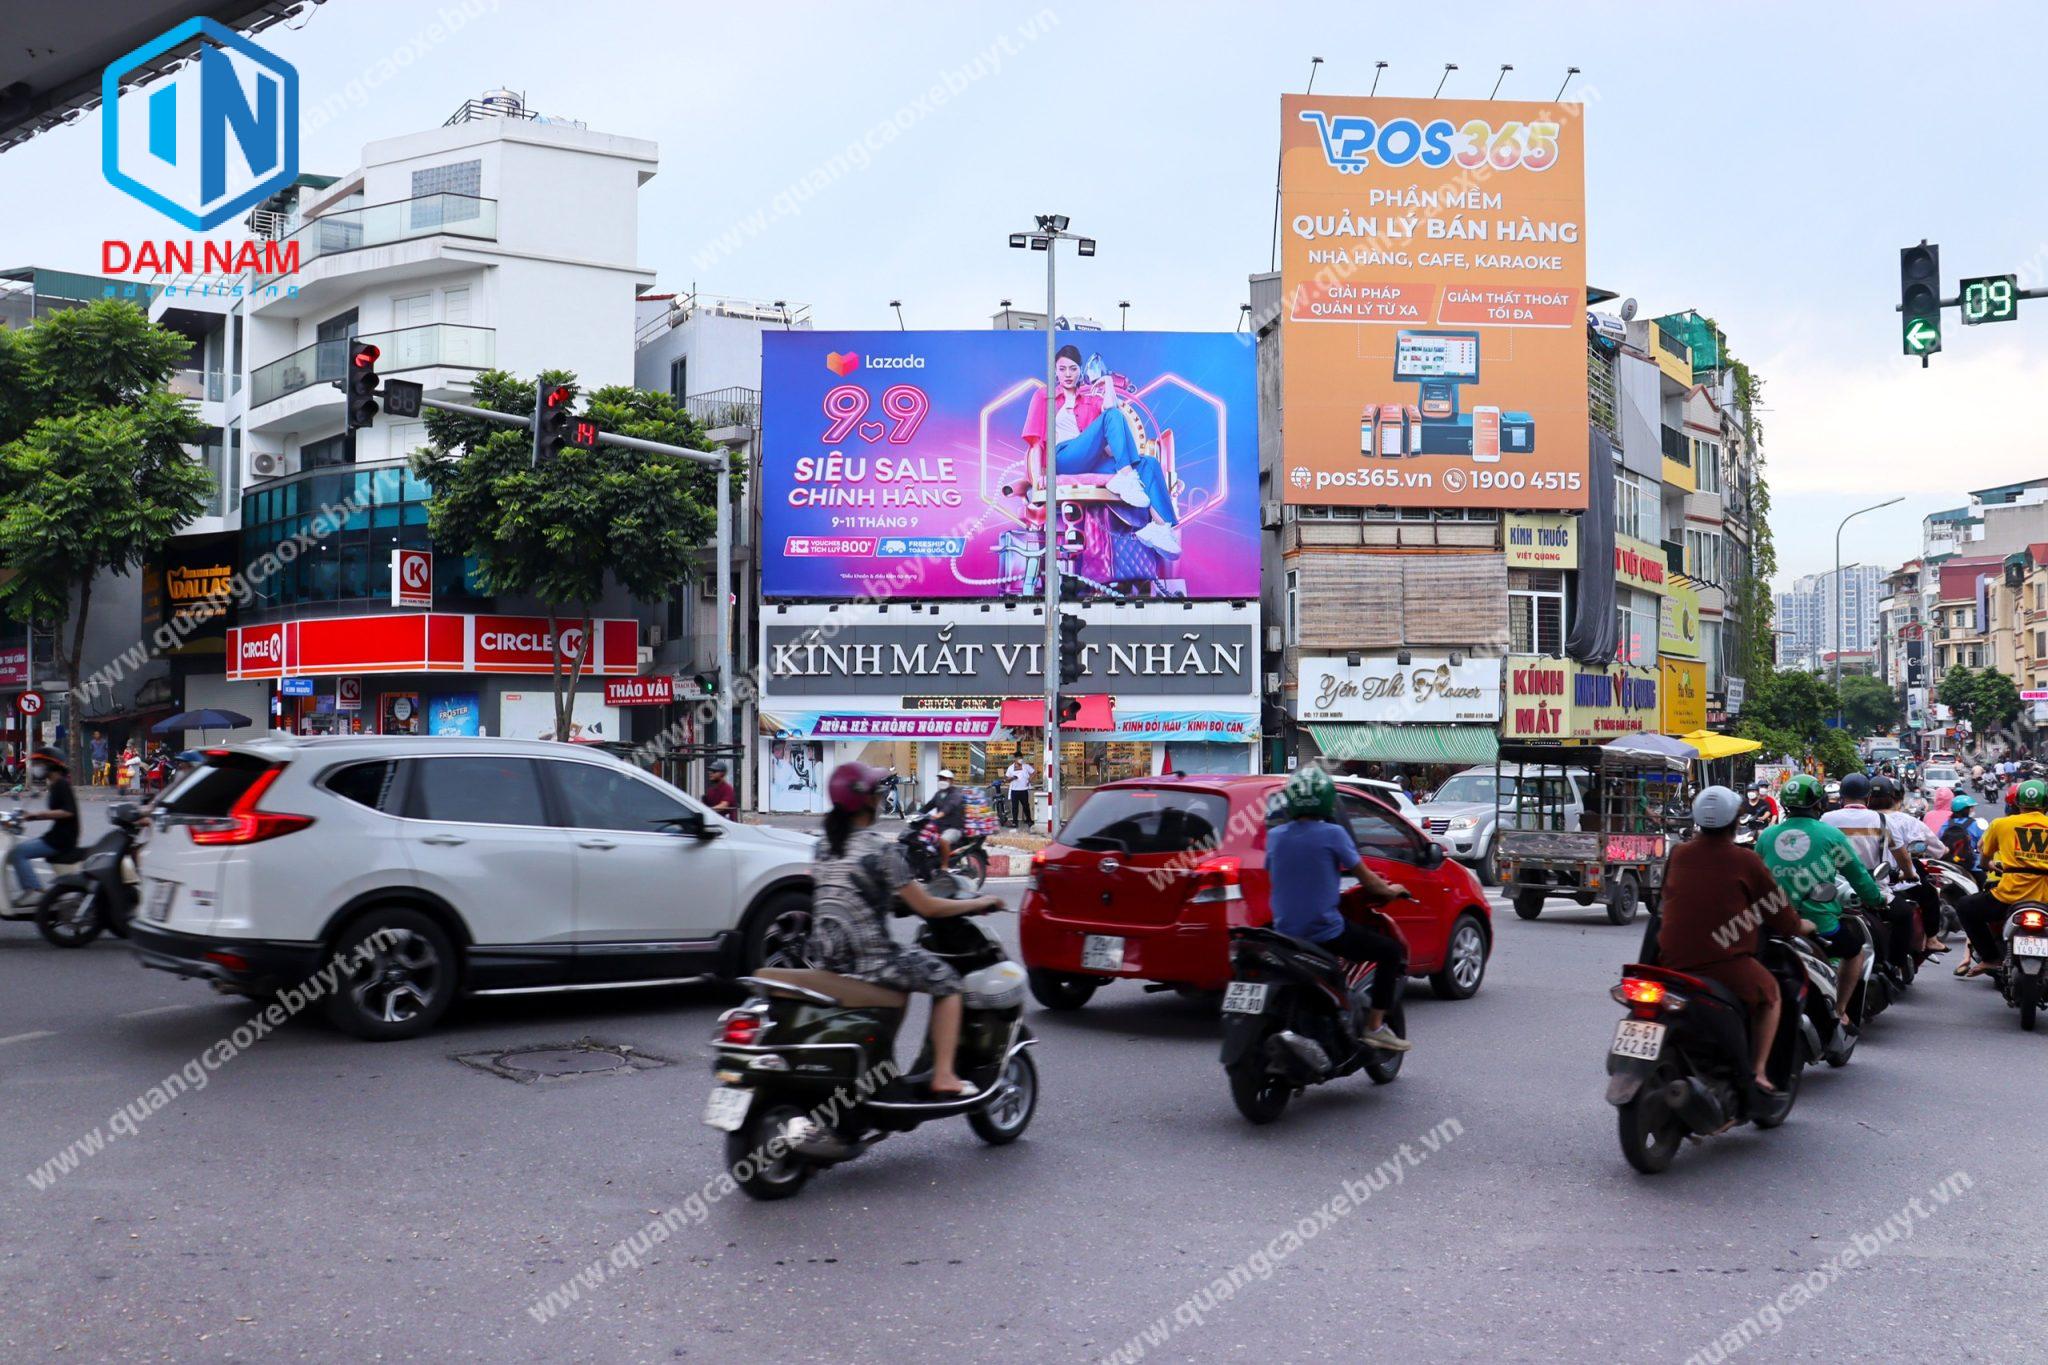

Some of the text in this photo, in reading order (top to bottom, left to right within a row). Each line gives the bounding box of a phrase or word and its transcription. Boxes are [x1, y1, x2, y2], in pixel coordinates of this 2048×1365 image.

[1331, 117, 1560, 171] POS365
[1370, 185, 1502, 211] PHẦN MỀM
[1292, 209, 1579, 244] QUẢN LÝ BÁN HÀNG
[1308, 247, 1562, 271] NHÀ HÀNG, CAFE, KARAOKE
[1328, 284, 1401, 299] GIẢI PHÁP
[1447, 287, 1569, 306] GIẢM THẤT THOÁT
[1965, 281, 2012, 318] 09
[1311, 299, 1418, 316] QUẢN LÝ TỪ XA
[1488, 305, 1534, 320] TỐI ĐA
[865, 353, 926, 369] Lazada
[577, 422, 594, 446] 14
[793, 450, 958, 482] SIÊU SALE
[1316, 468, 1580, 490] pos365.vn 1900 4515
[787, 483, 962, 506] CHÍNH HÃNG
[831, 514, 919, 528] 9-11 THÁNG 9
[1510, 524, 1569, 547] KÍNH THUỐC
[1516, 550, 1561, 561] VIỆT QUANG
[1622, 547, 1639, 580] VIỆT
[1640, 556, 1664, 584] QUANG
[173, 577, 232, 600] DALLAS
[242, 641, 269, 659] CIRCLE
[480, 632, 553, 651] CIRCLE
[772, 622, 1245, 676] KÍNH MẮT VIT NHÃN
[608, 678, 670, 698] THẢO VẢI
[1315, 673, 1359, 710] Yến
[1513, 663, 1565, 734] KÍNH MẮT
[440, 707, 468, 719] FROSTER
[917, 697, 956, 710] CHUYÊN
[961, 699, 988, 710] CUNG
[820, 717, 847, 733] MÙA
[849, 718, 870, 733] HÈ
[871, 717, 916, 733] KHÔNG
